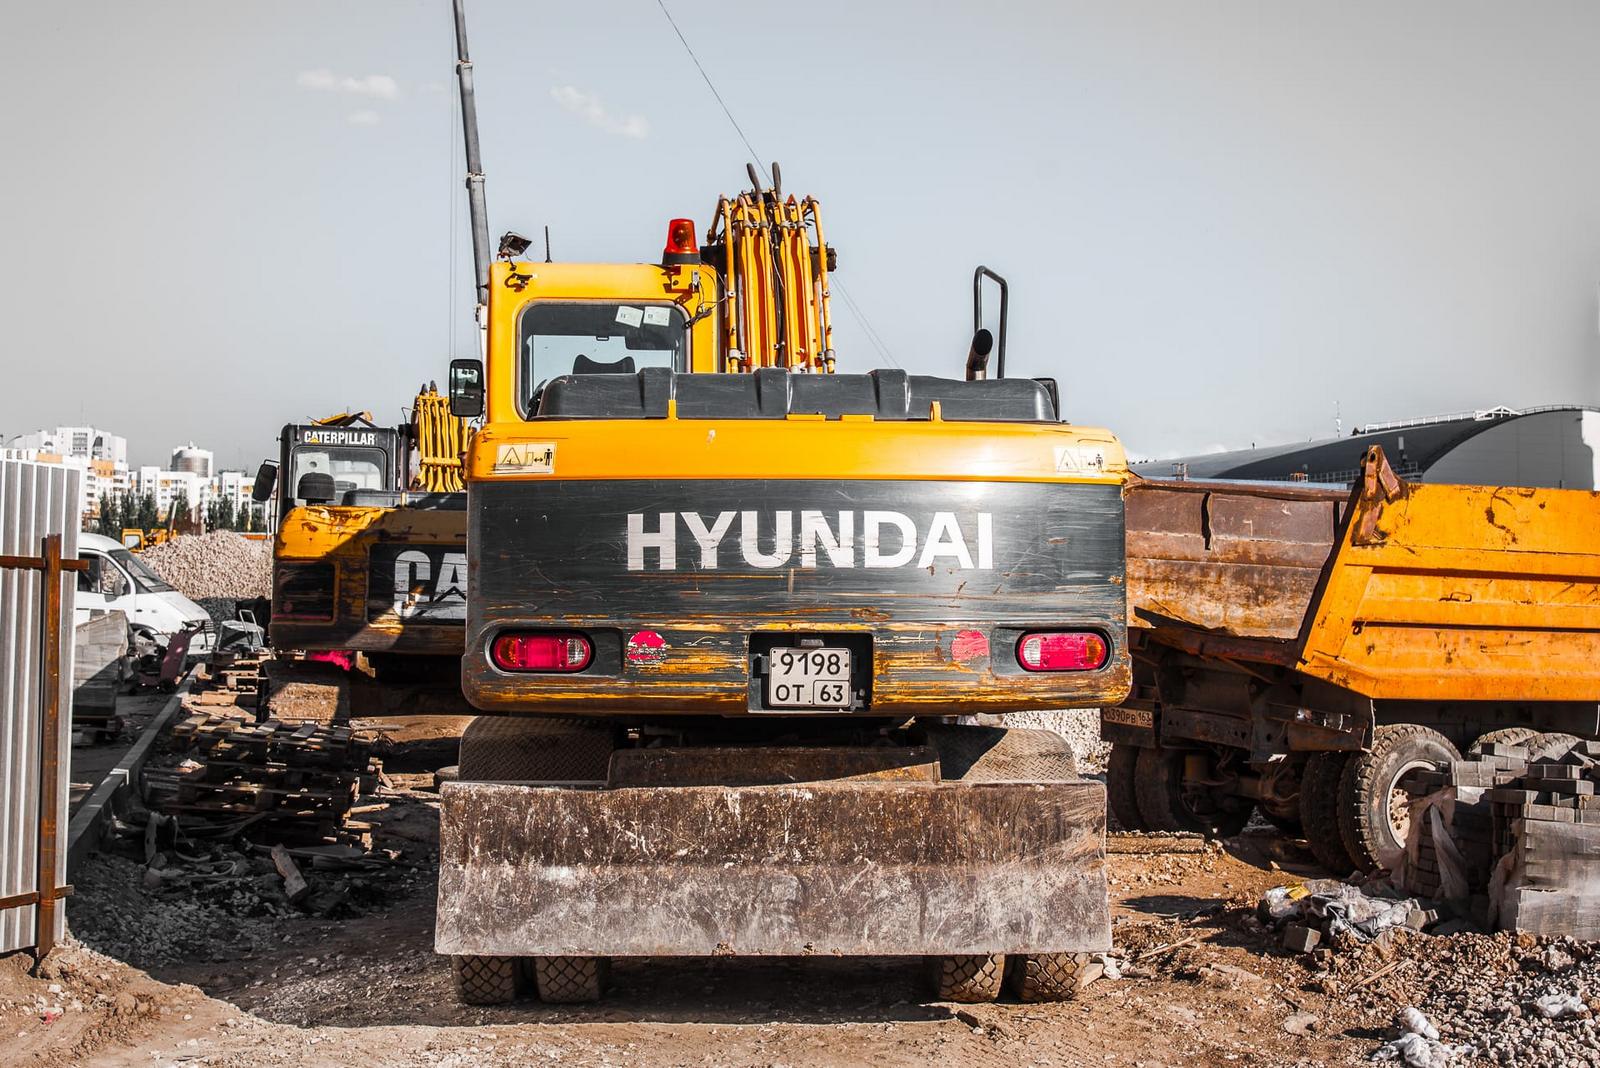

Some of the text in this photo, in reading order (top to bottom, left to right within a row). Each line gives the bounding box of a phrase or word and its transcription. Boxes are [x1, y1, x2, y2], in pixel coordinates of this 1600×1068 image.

[304, 430, 375, 446] CATERPILLAR
[627, 510, 993, 571] HYUNDAI
[780, 653, 841, 675] 9198
[775, 684, 843, 702] OT 63
